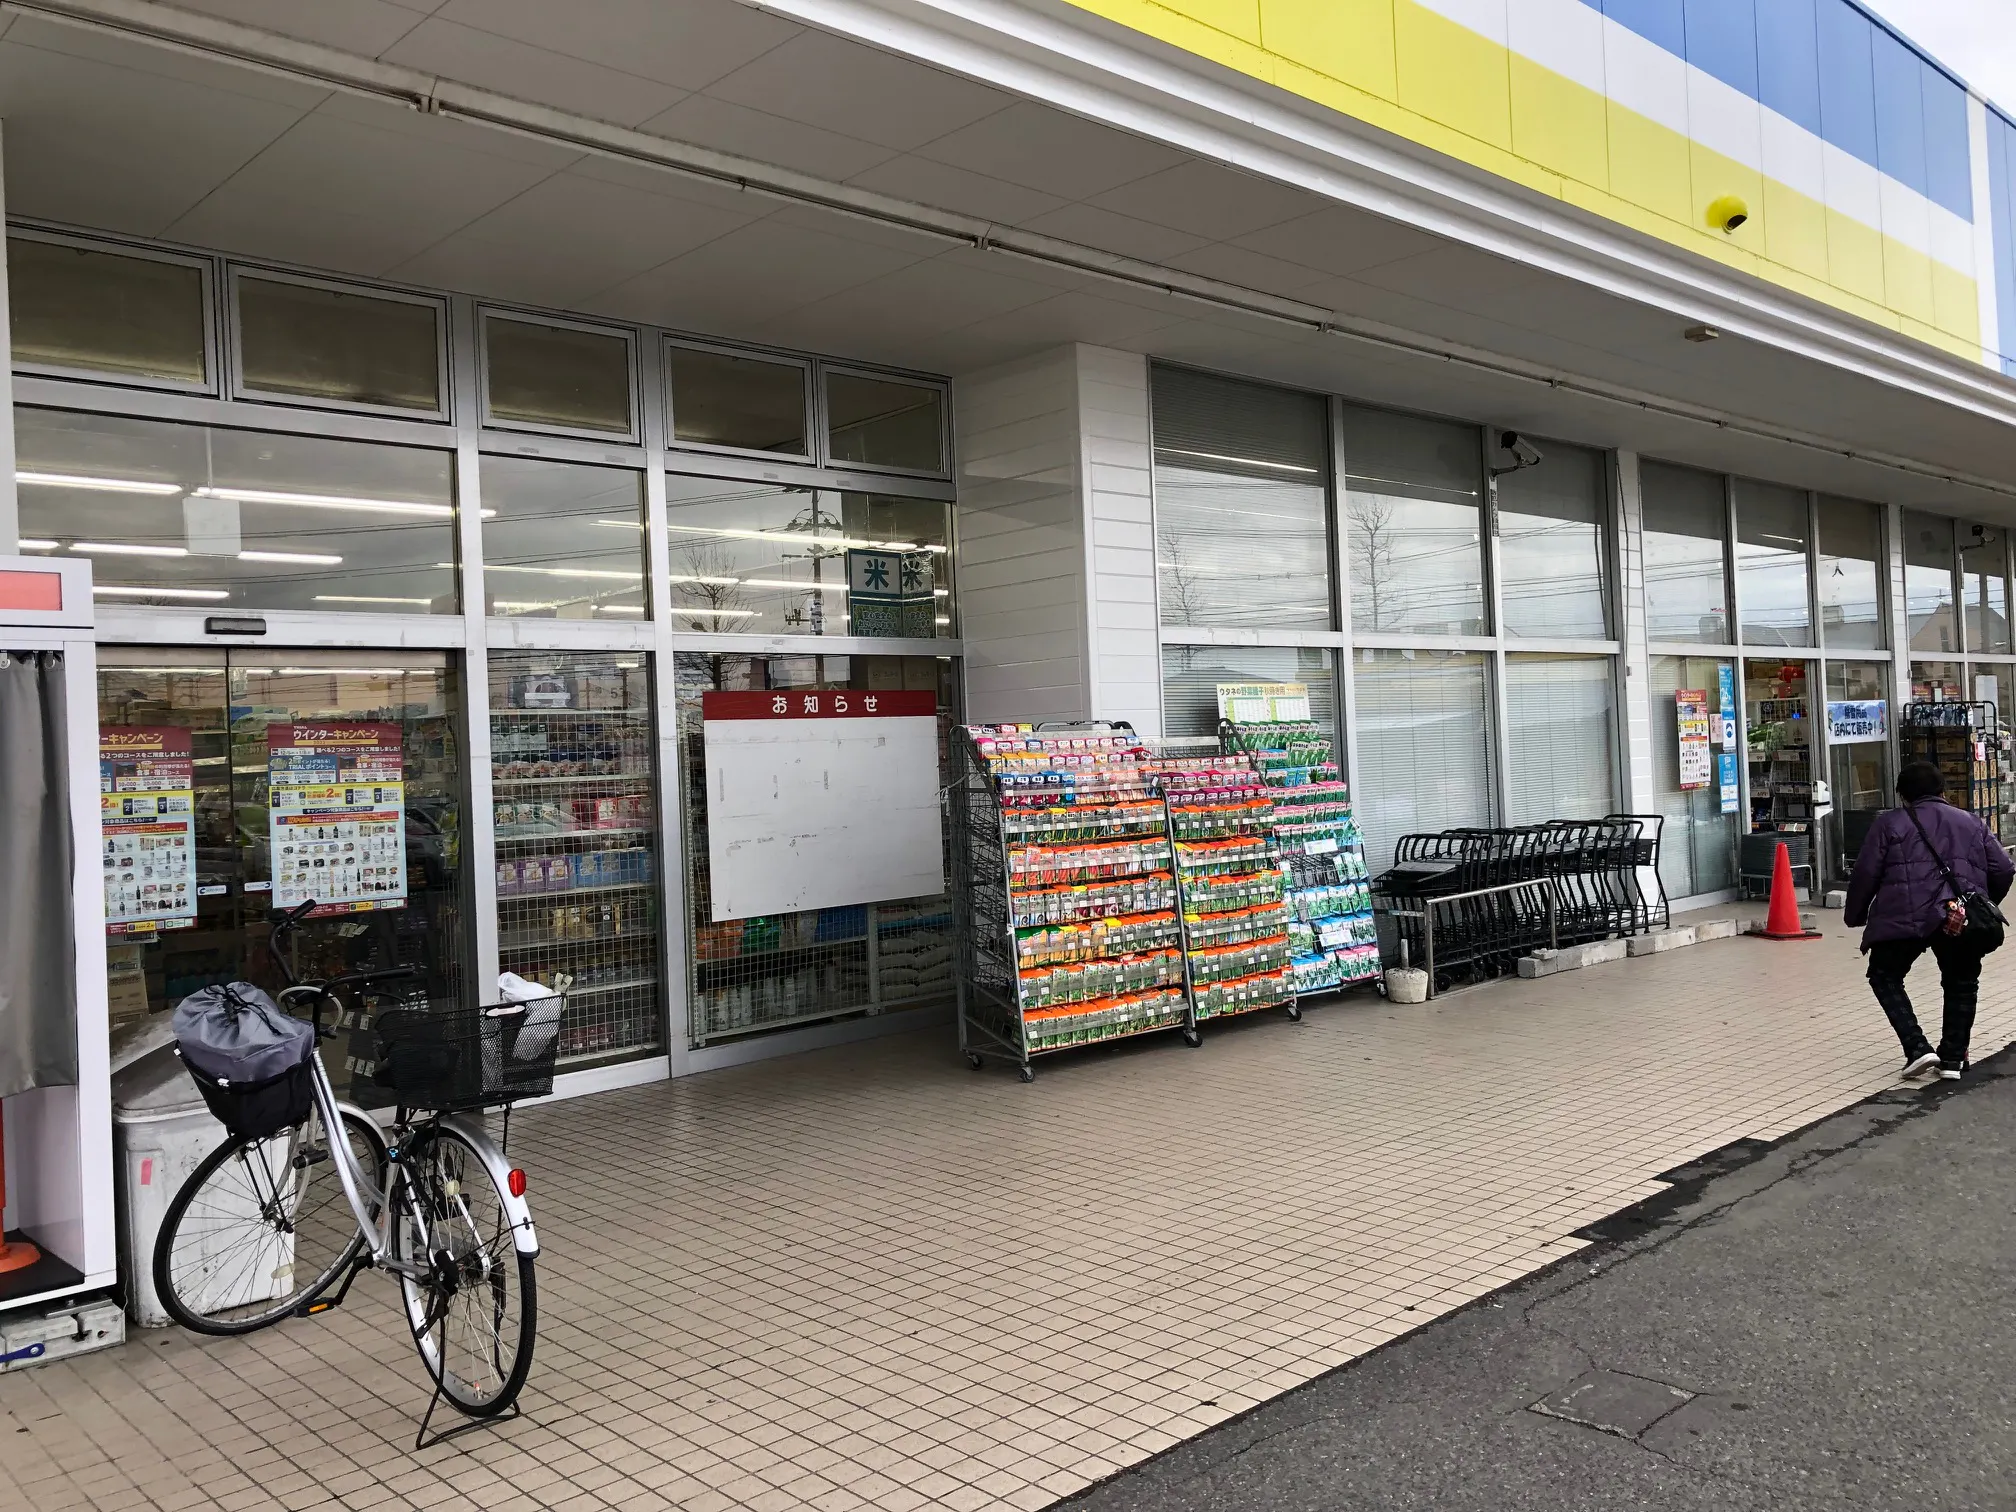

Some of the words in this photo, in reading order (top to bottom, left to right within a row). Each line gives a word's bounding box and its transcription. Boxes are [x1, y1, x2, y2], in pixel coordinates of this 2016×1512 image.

[864, 558, 890, 590] 米
[903, 560, 922, 591] 米
[772, 694, 878, 714] お知らせ
[293, 729, 379, 740] ウインターキャンペーン
